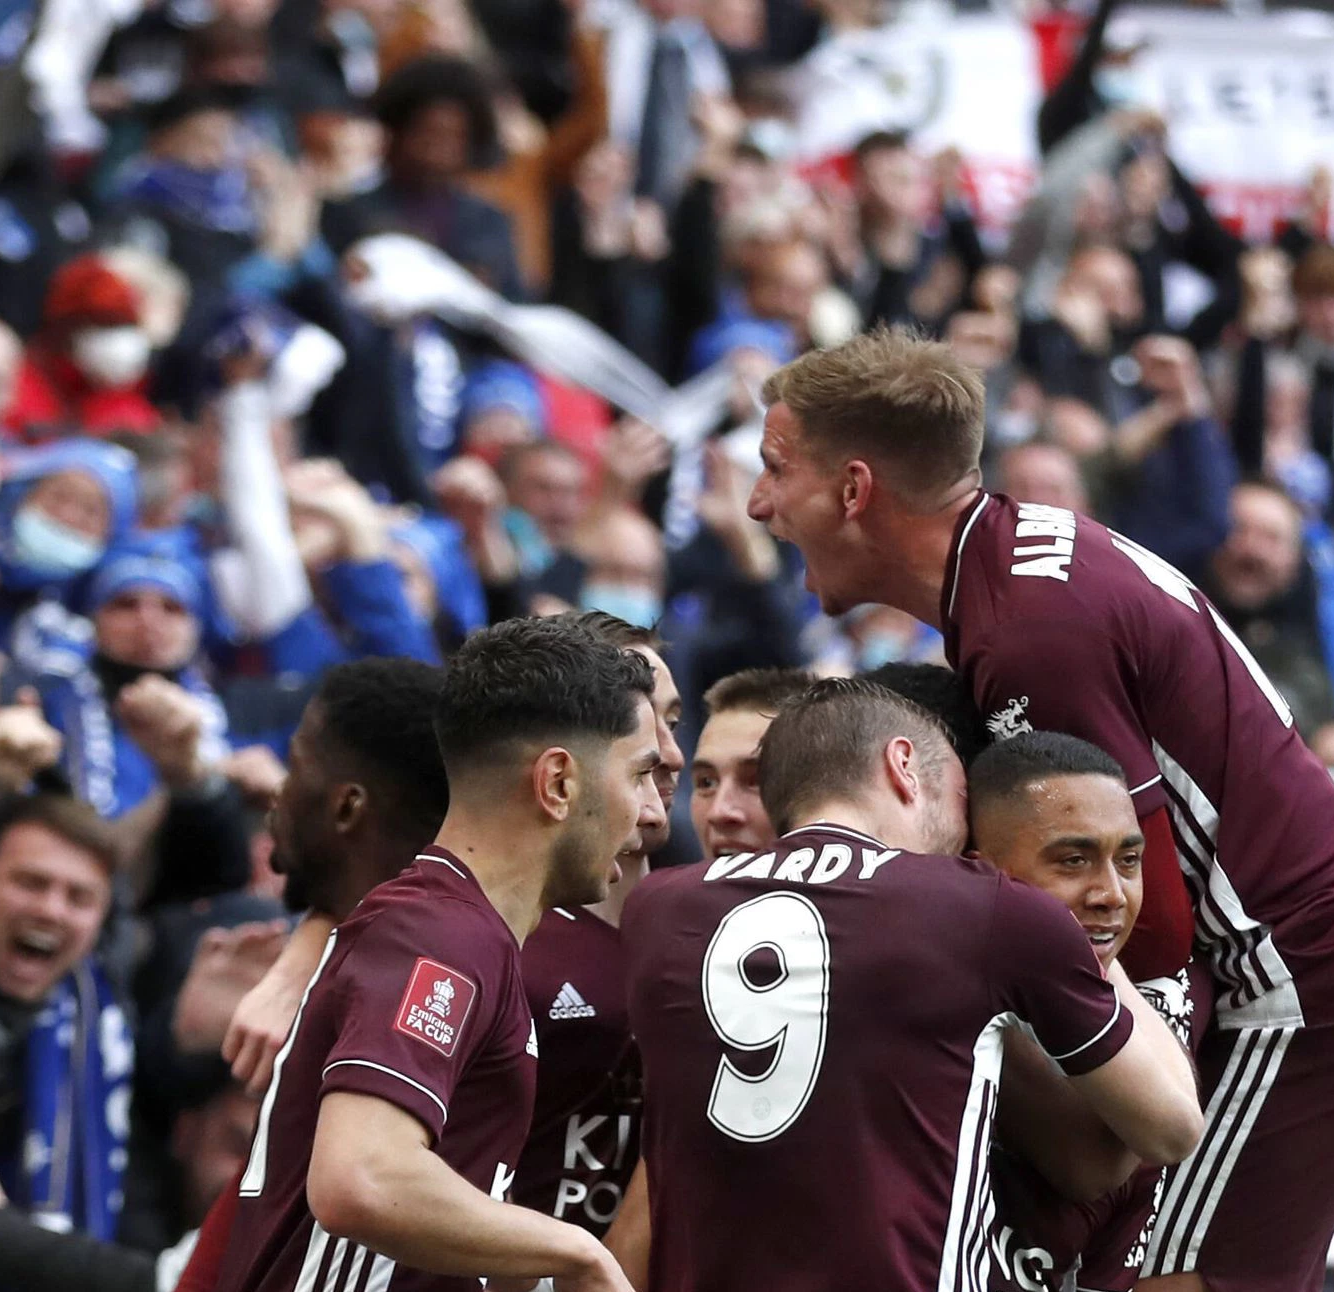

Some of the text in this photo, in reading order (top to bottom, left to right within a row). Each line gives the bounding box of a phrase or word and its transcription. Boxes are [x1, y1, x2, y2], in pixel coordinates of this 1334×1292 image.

[702, 842, 901, 885] VARDY
[405, 1014, 453, 1045] FA CUP
[410, 1003, 455, 1036] Emirates
[701, 889, 831, 1144] 9
